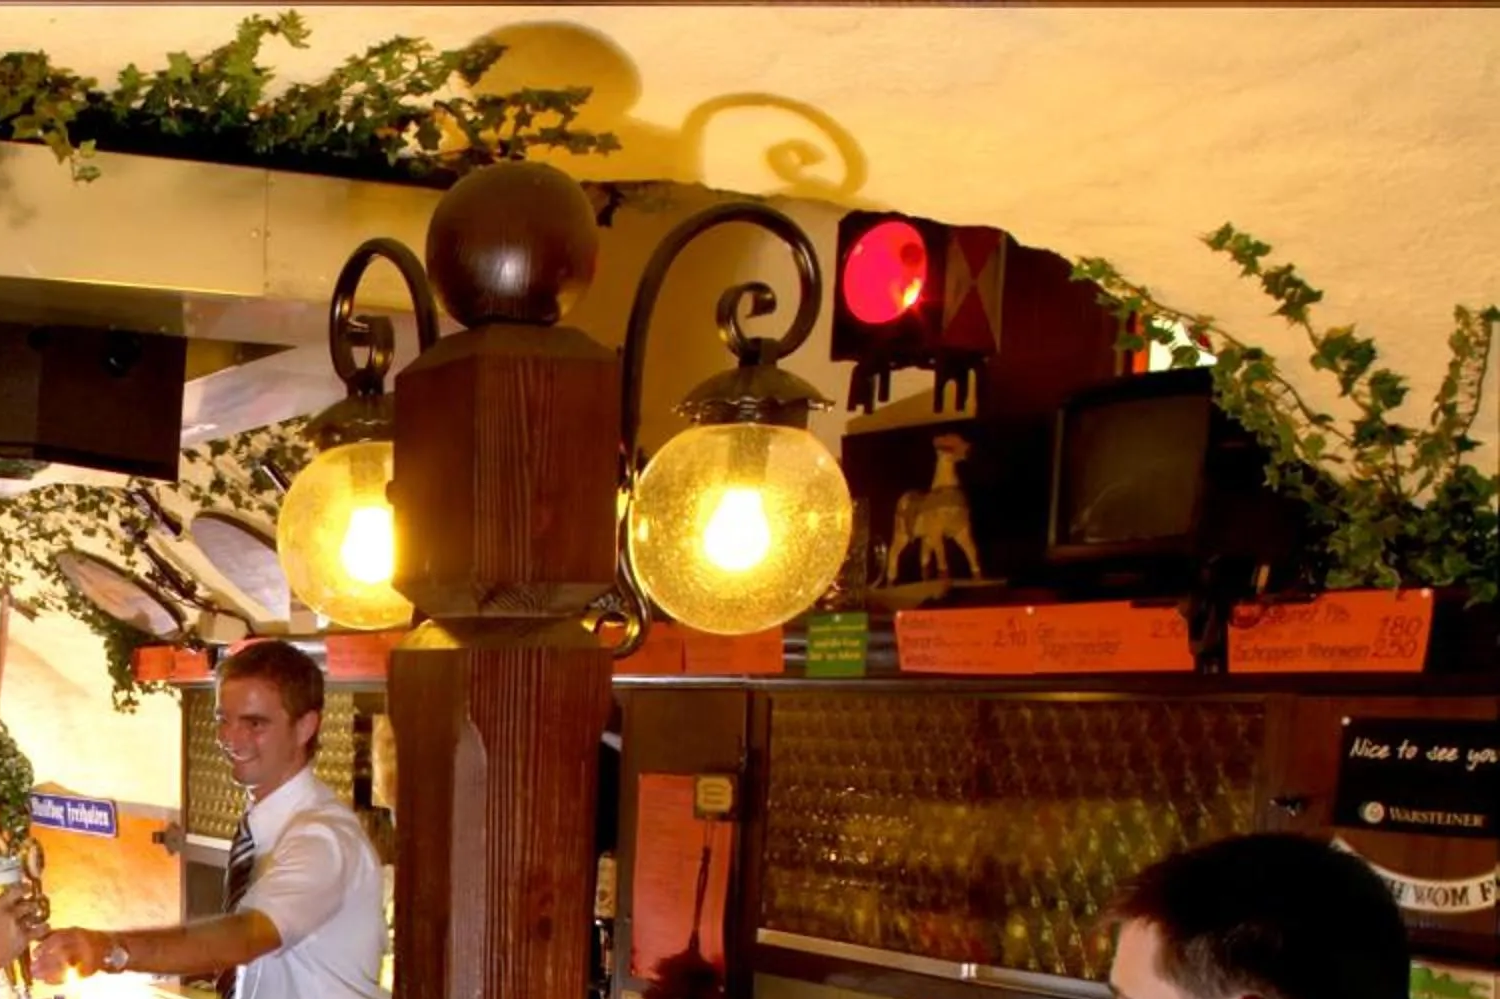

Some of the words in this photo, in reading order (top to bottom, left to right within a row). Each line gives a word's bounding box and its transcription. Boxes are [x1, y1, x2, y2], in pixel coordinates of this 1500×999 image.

[1349, 736, 1391, 759] Nice
[1396, 738, 1418, 760] to
[1425, 745, 1459, 762] see
[1389, 806, 1485, 828] WARSTEINER
